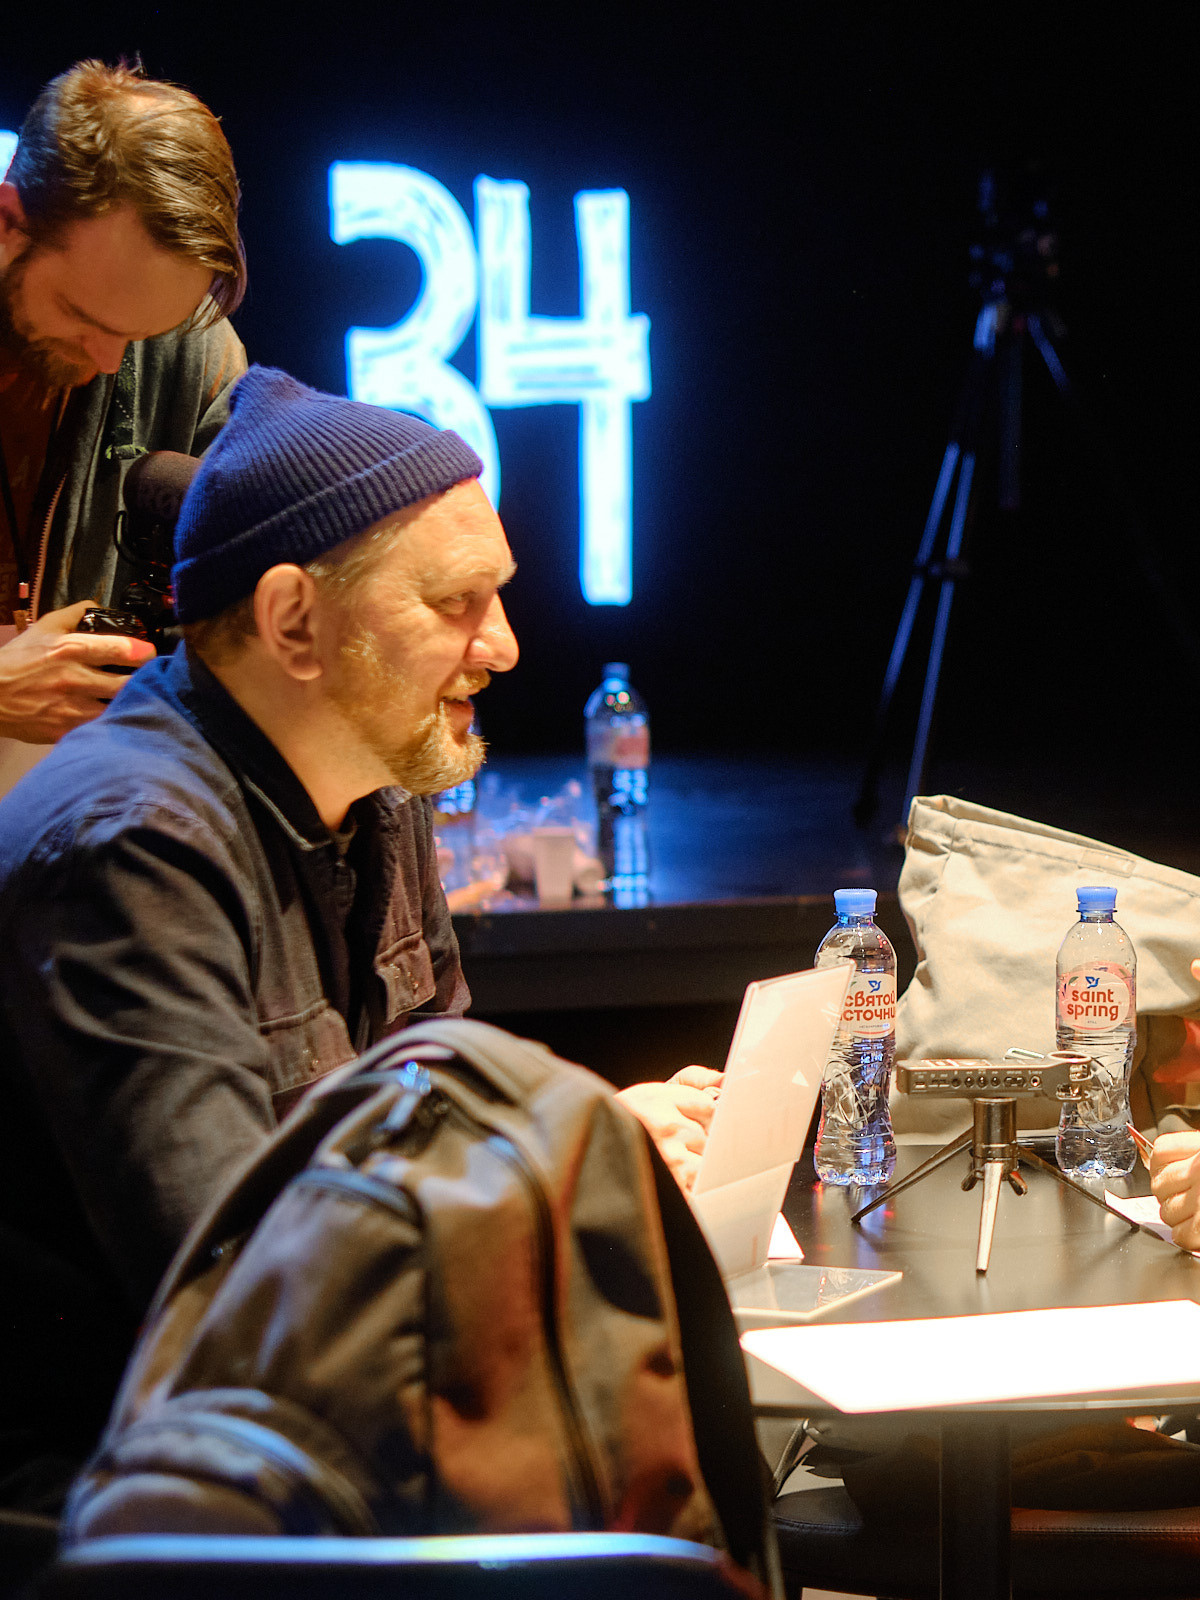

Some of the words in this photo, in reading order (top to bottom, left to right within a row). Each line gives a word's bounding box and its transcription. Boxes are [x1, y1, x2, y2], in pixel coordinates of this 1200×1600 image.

[1071, 989, 1114, 1003] saint
[840, 1006, 896, 1021] сточни
[1067, 1003, 1119, 1021] spring
